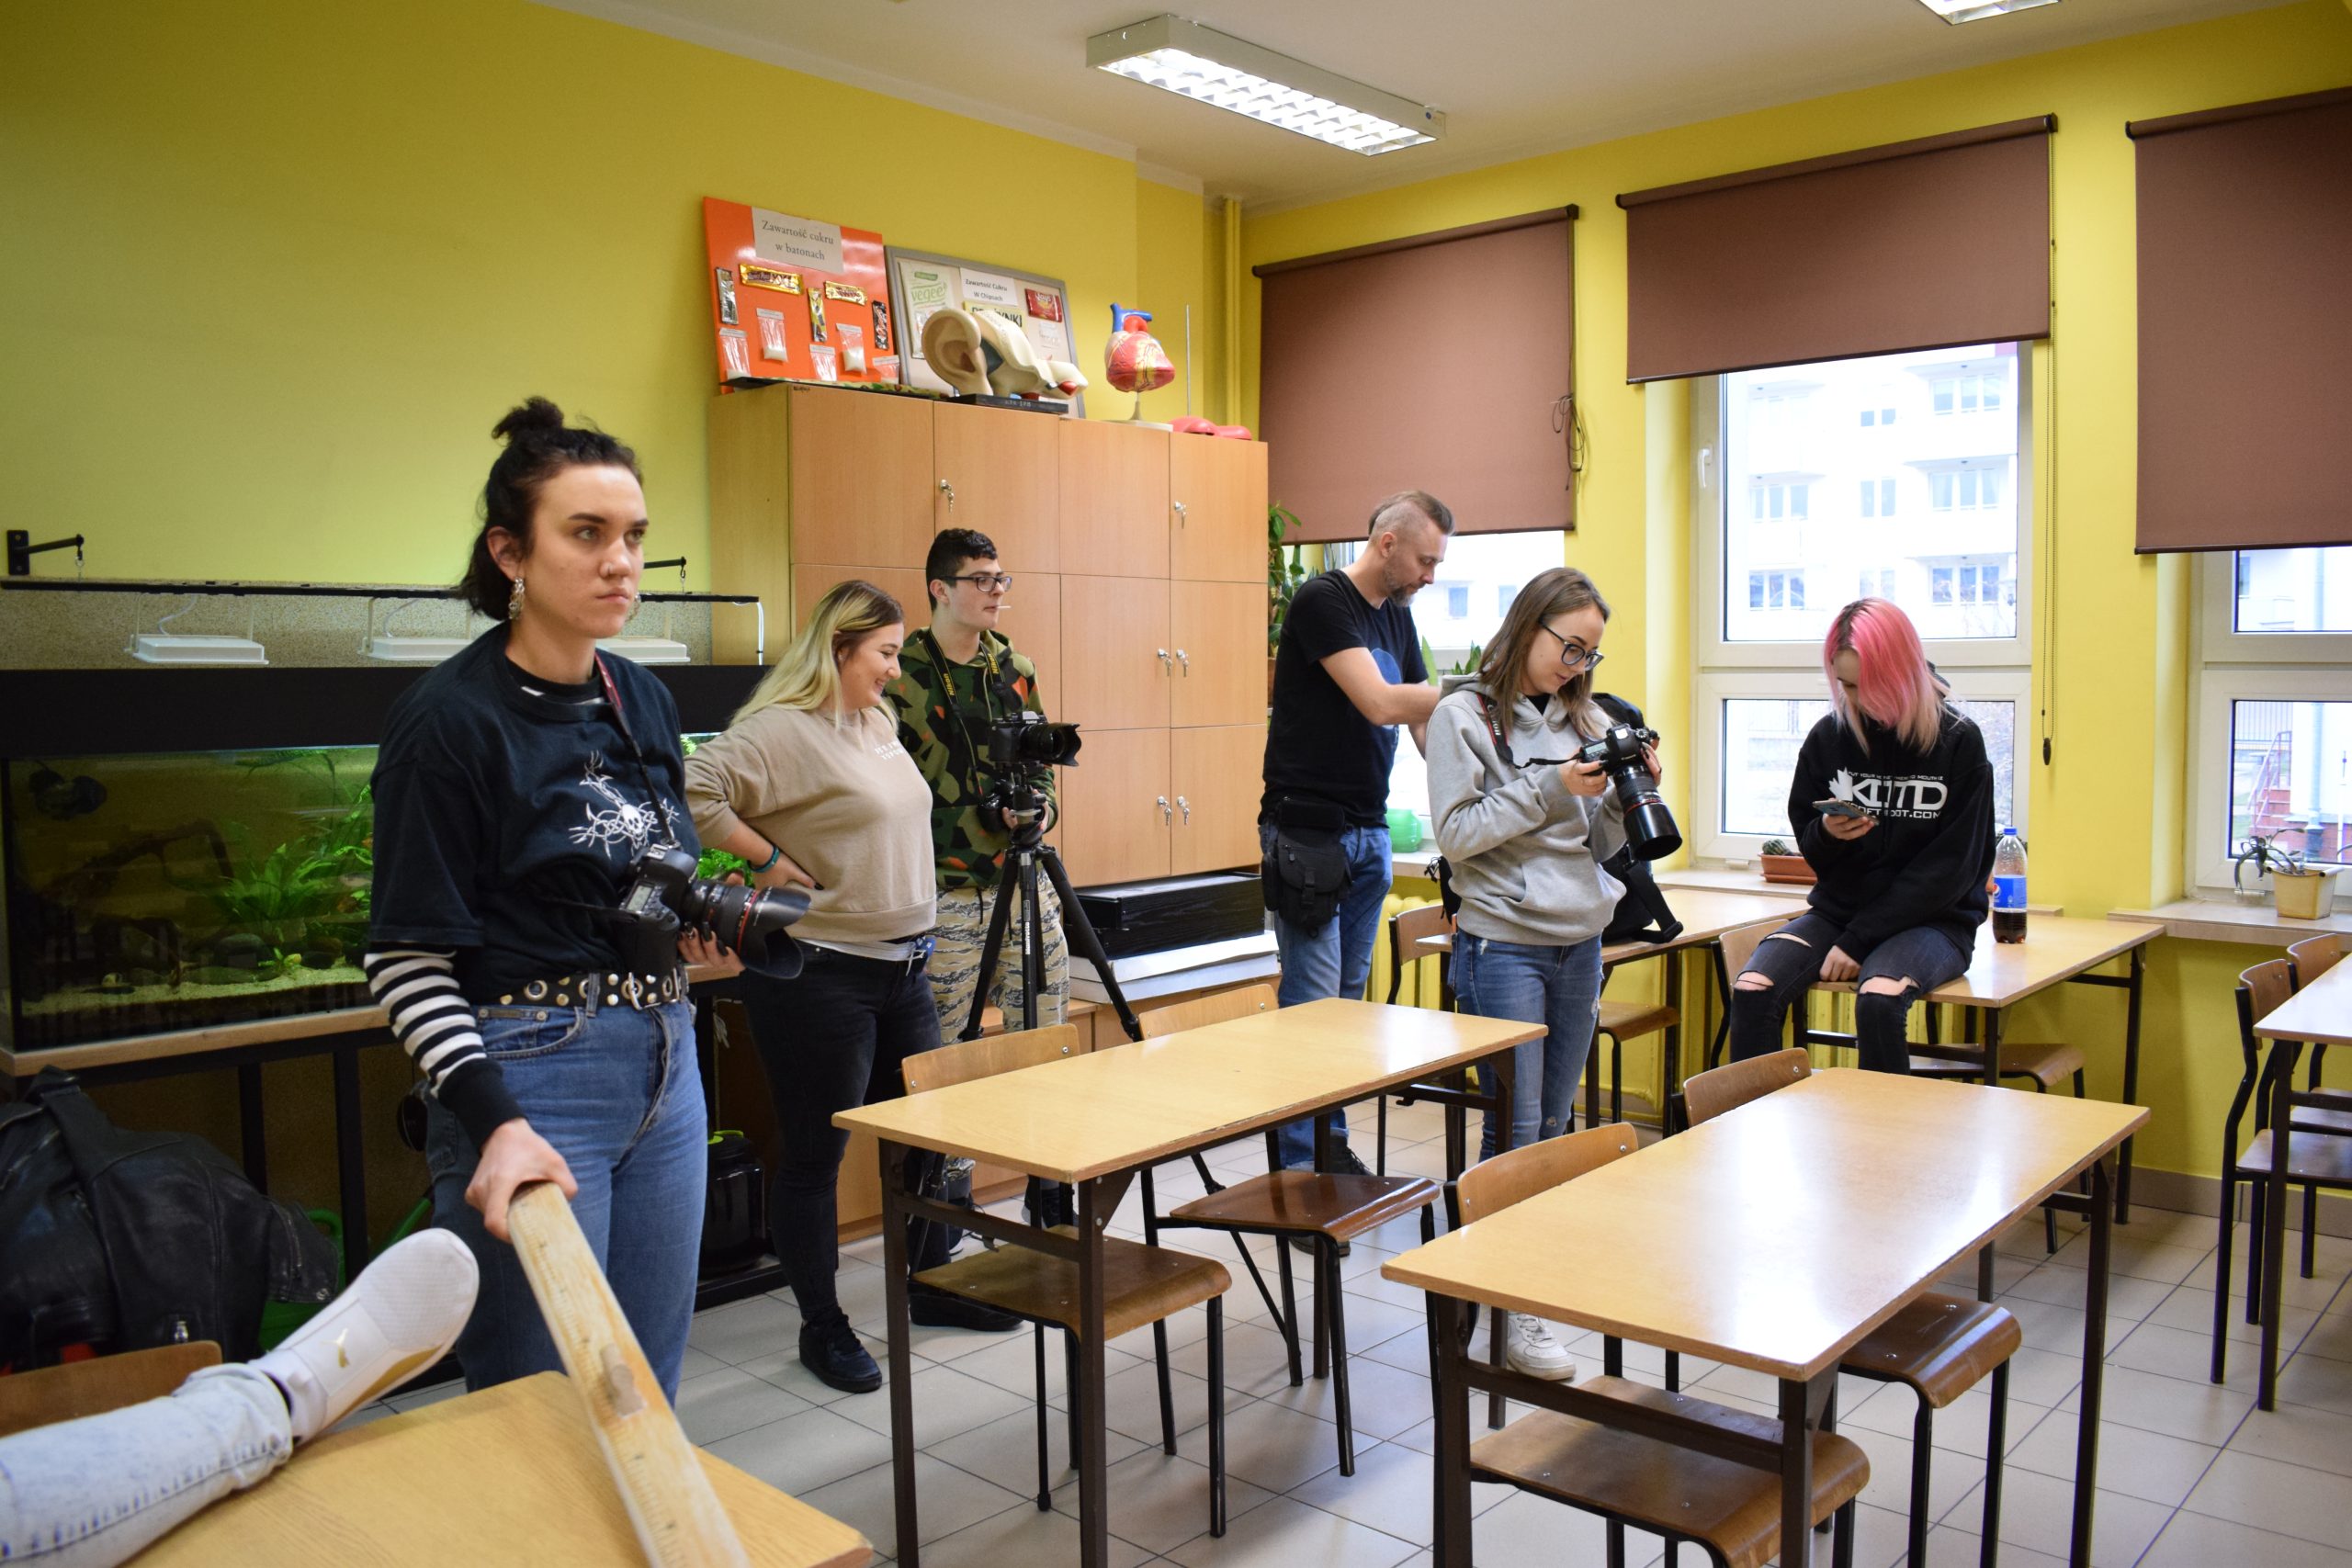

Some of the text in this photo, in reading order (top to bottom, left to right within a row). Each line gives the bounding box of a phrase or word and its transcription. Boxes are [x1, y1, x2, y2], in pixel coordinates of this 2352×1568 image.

[761, 220, 834, 245] Zawartość cukru
[775, 243, 825, 261] w batonach
[943, 672, 956, 696] Nikon
